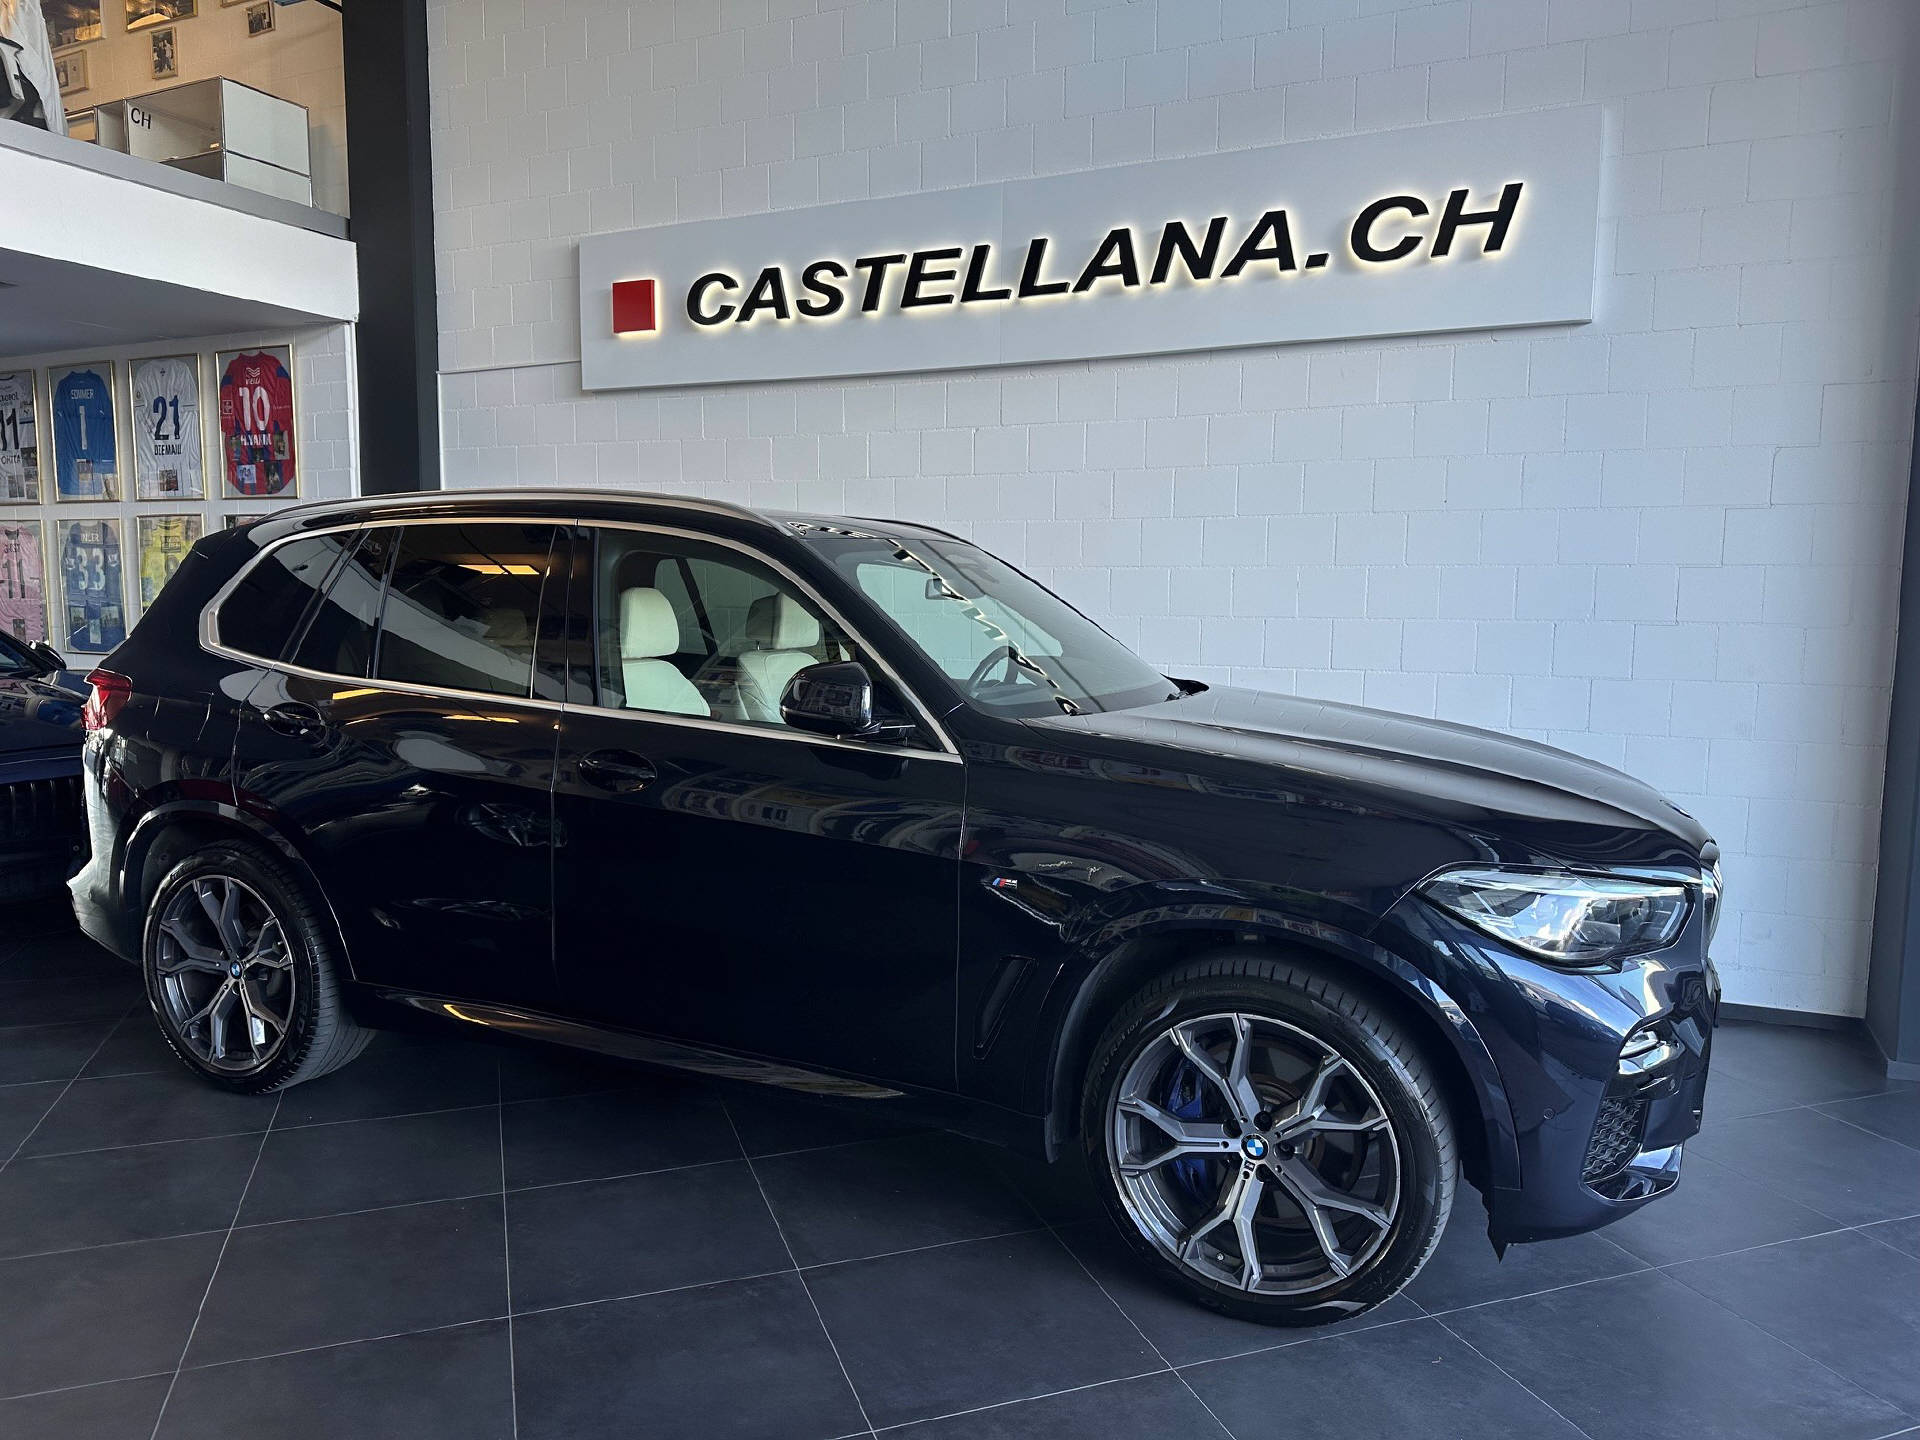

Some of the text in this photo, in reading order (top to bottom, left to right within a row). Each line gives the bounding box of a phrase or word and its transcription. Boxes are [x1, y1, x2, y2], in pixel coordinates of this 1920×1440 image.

[131, 107, 151, 130] CH
[686, 182, 1525, 326] CASTELLANA.CH
[79, 405, 88, 450] 1
[153, 395, 180, 440] 21
[239, 386, 271, 431] 10
[76, 546, 106, 590] 33
